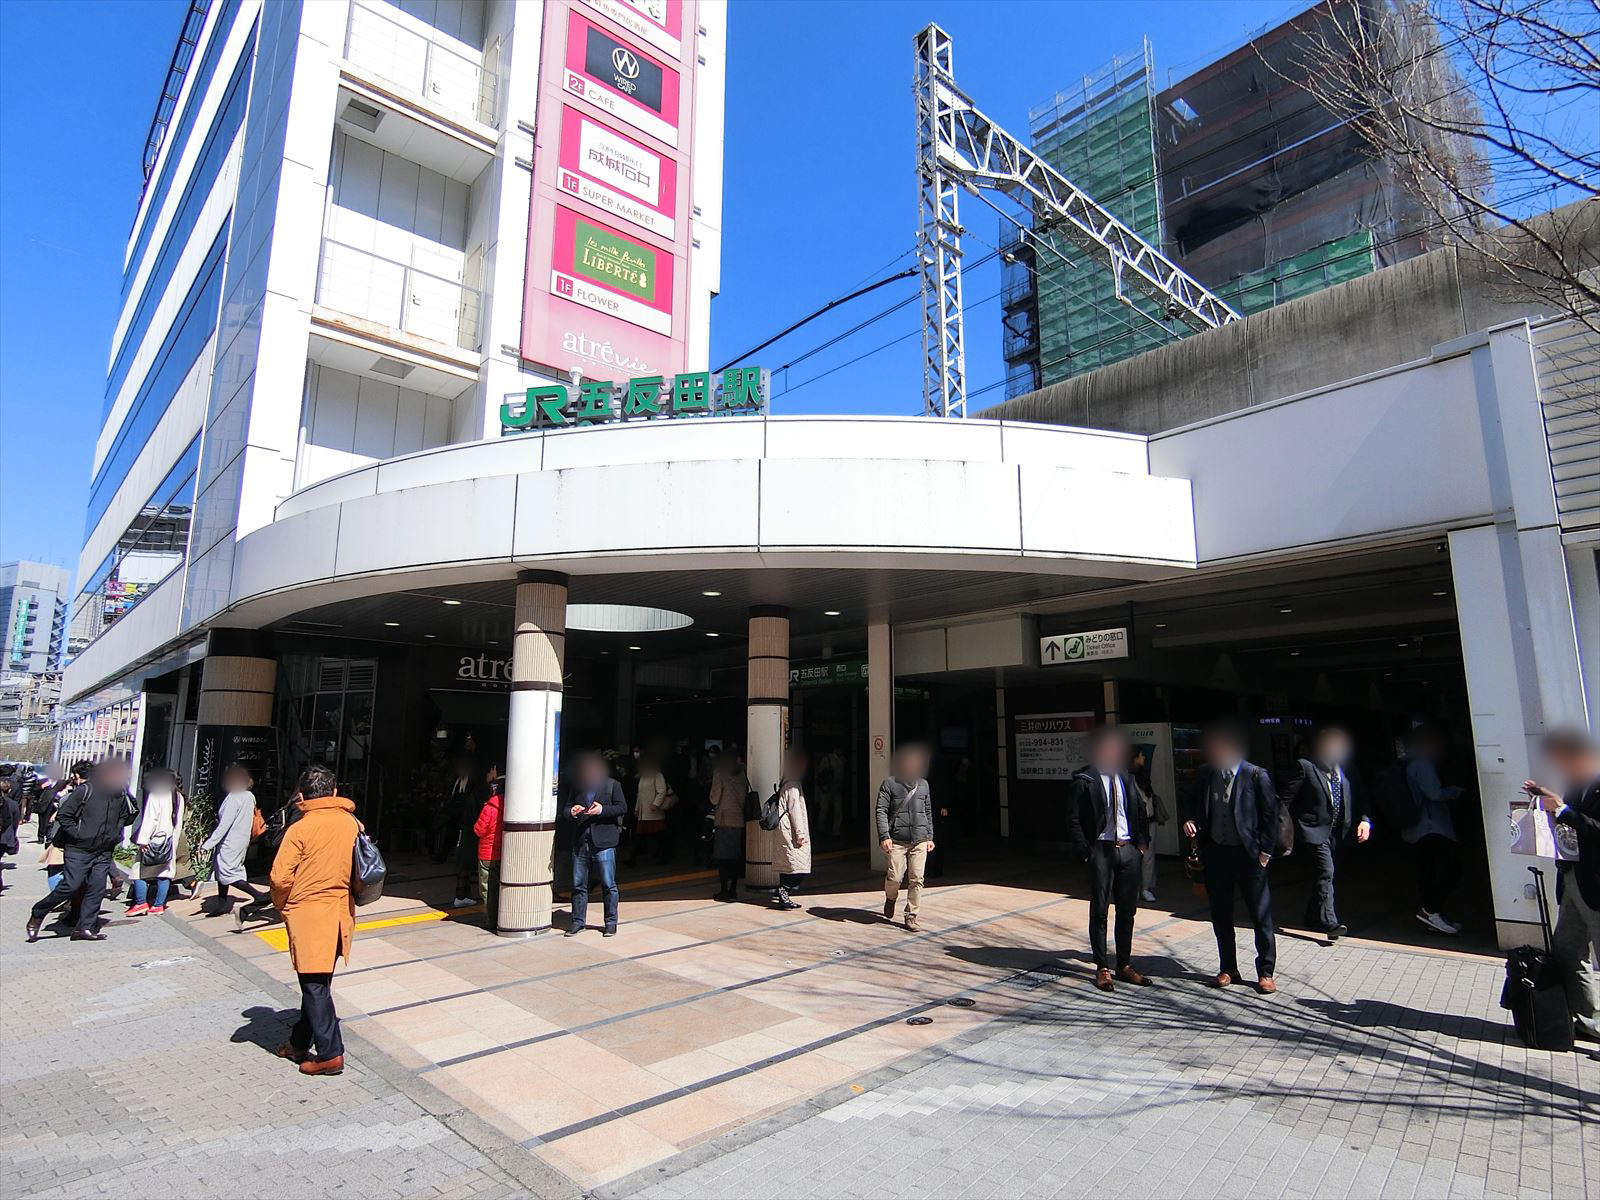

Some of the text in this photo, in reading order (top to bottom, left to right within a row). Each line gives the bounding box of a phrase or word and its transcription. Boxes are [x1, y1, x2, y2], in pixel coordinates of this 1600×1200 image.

[613, 73, 637, 92] WIRED
[569, 78, 616, 110] 2F CAFE
[566, 176, 655, 226] 1F SUPER MARKET
[558, 279, 620, 313] 1F FLOWER
[562, 331, 658, 374] atrévie
[1085, 631, 1124, 643] みどりの窓口
[1101, 642, 1116, 650] Office
[1020, 720, 1072, 731] 三井のリハウス
[1131, 729, 1154, 737] acure
